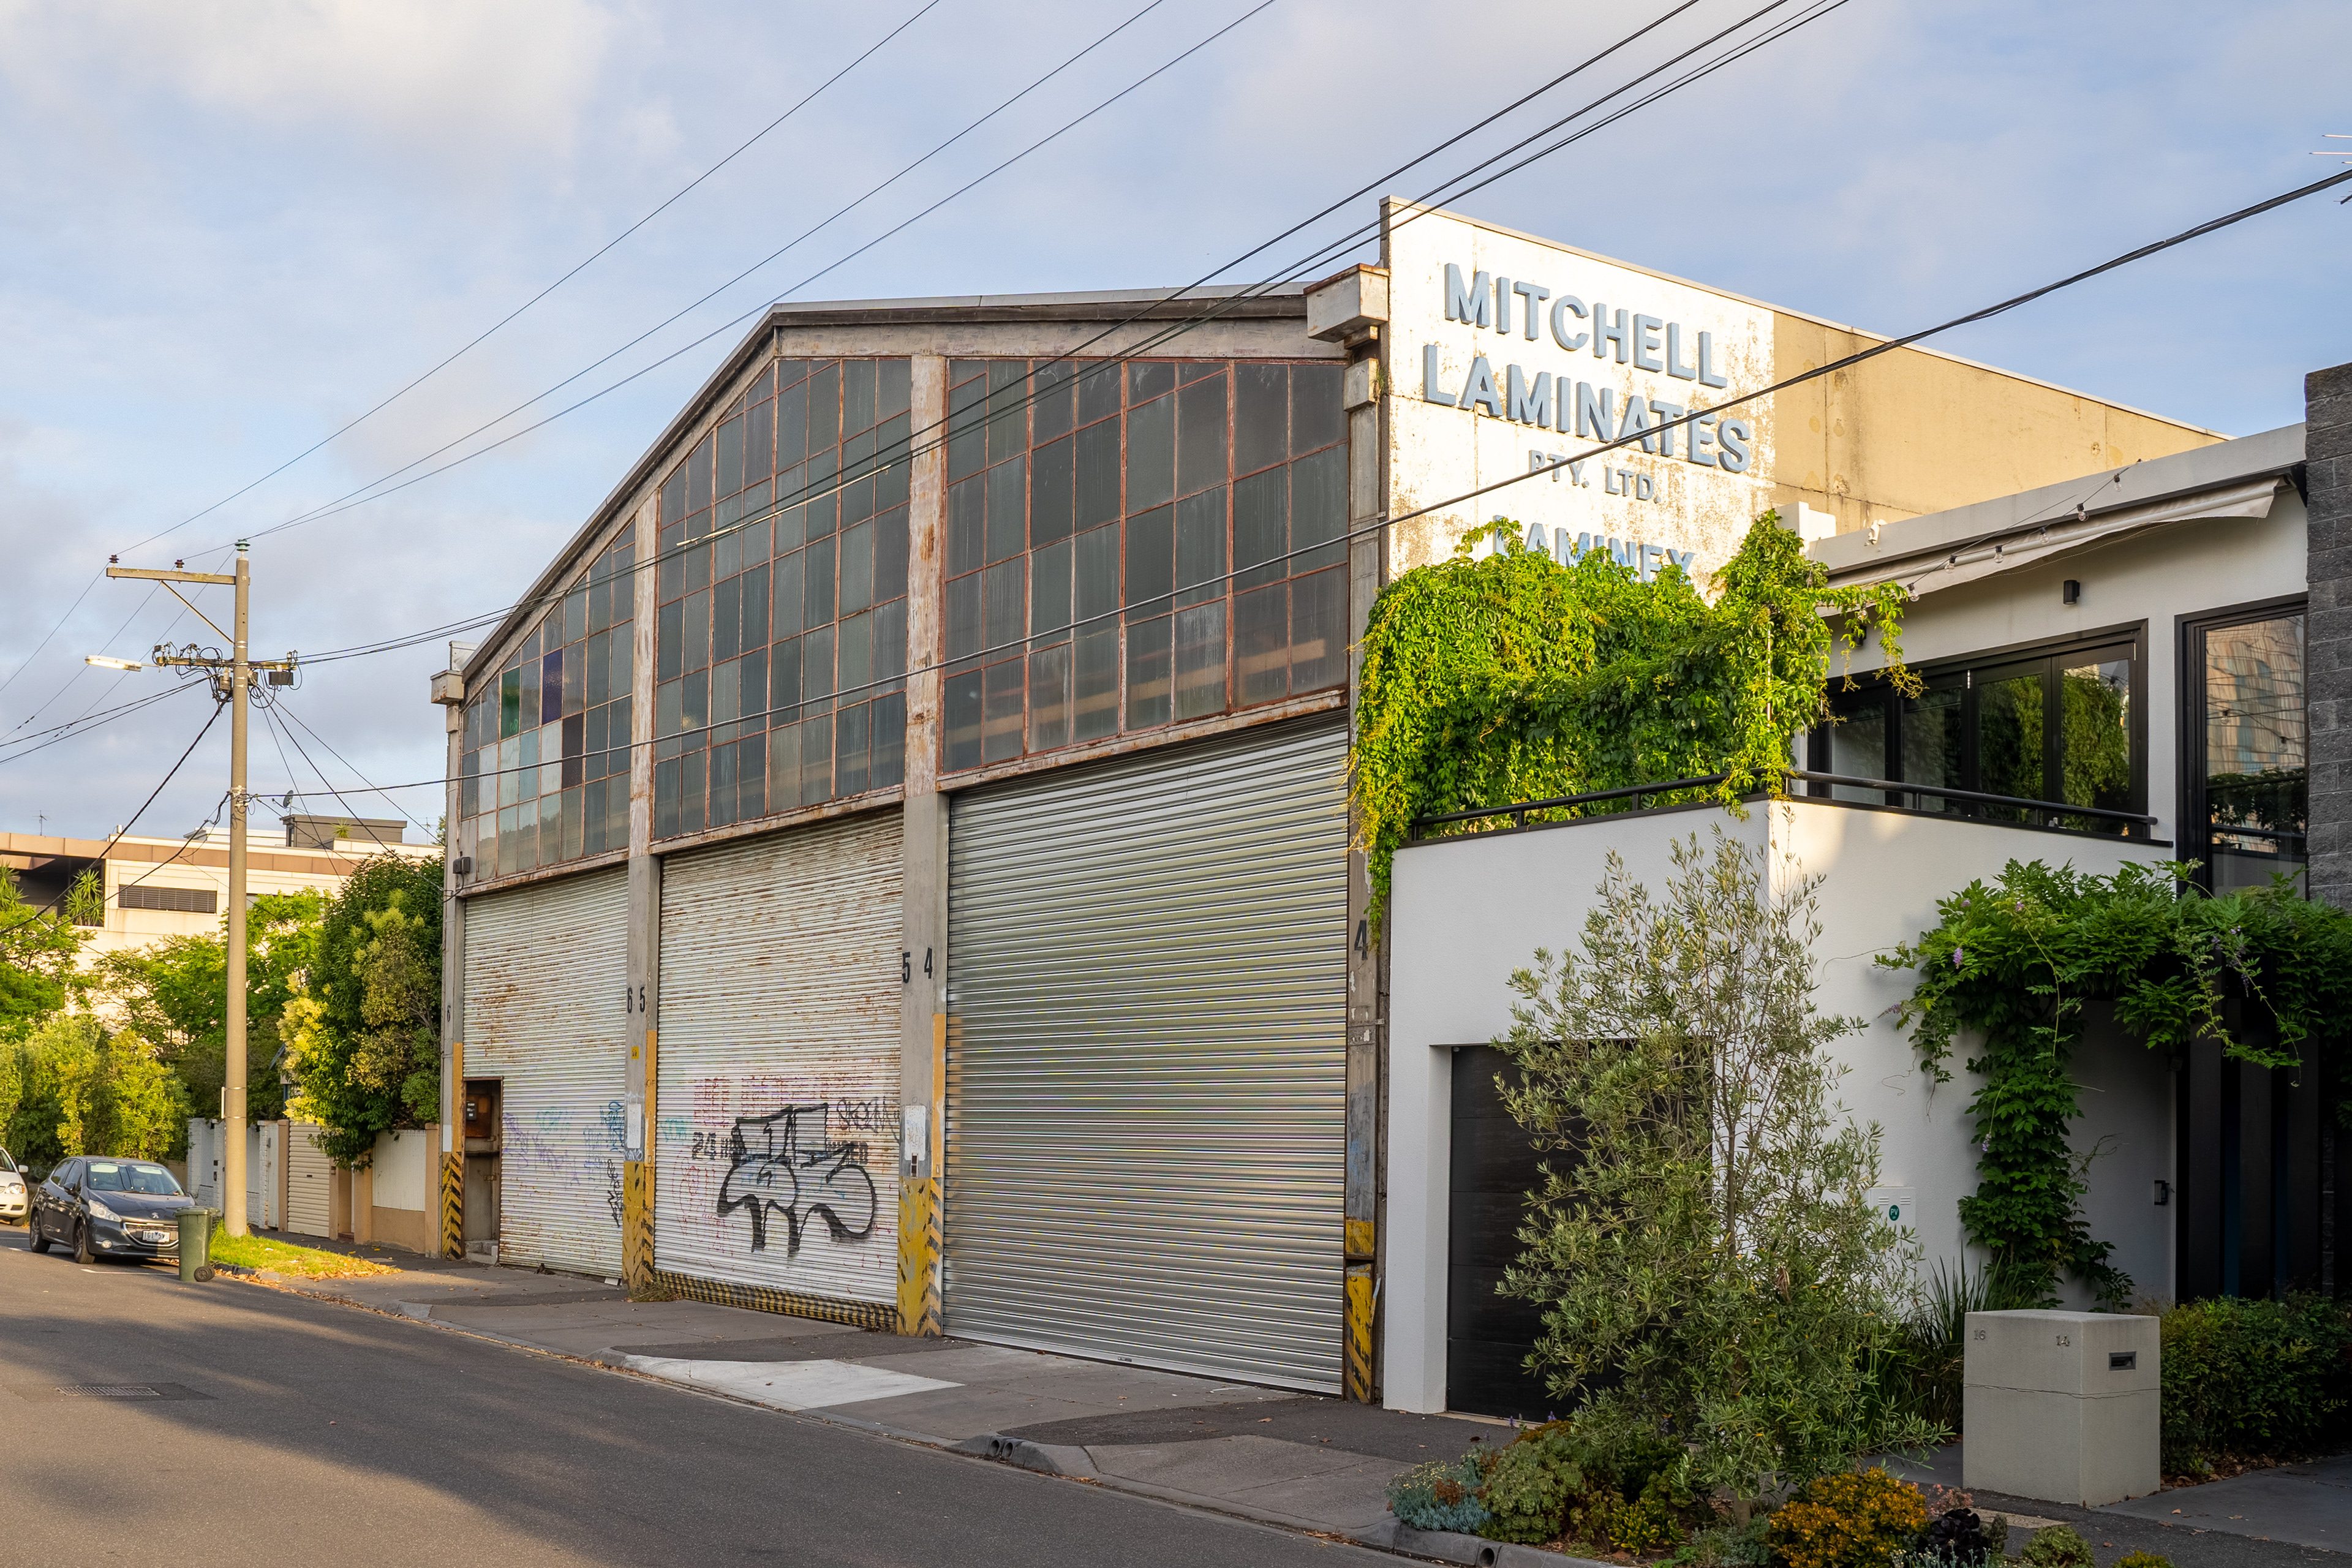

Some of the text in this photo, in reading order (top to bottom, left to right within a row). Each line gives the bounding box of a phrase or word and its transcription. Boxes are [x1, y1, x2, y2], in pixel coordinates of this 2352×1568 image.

[1444, 262, 1727, 389] MITCHELL
[1423, 344, 1751, 473] LAMINATES
[1529, 450, 1661, 504] PTY. LTD.
[1354, 919, 1368, 960] 4
[902, 947, 933, 984] 5 4
[447, 1005, 451, 1022] 6
[627, 986, 646, 1014] 6 5
[1974, 1330, 1986, 1340] 16
[2056, 1335, 2070, 1346] 14
